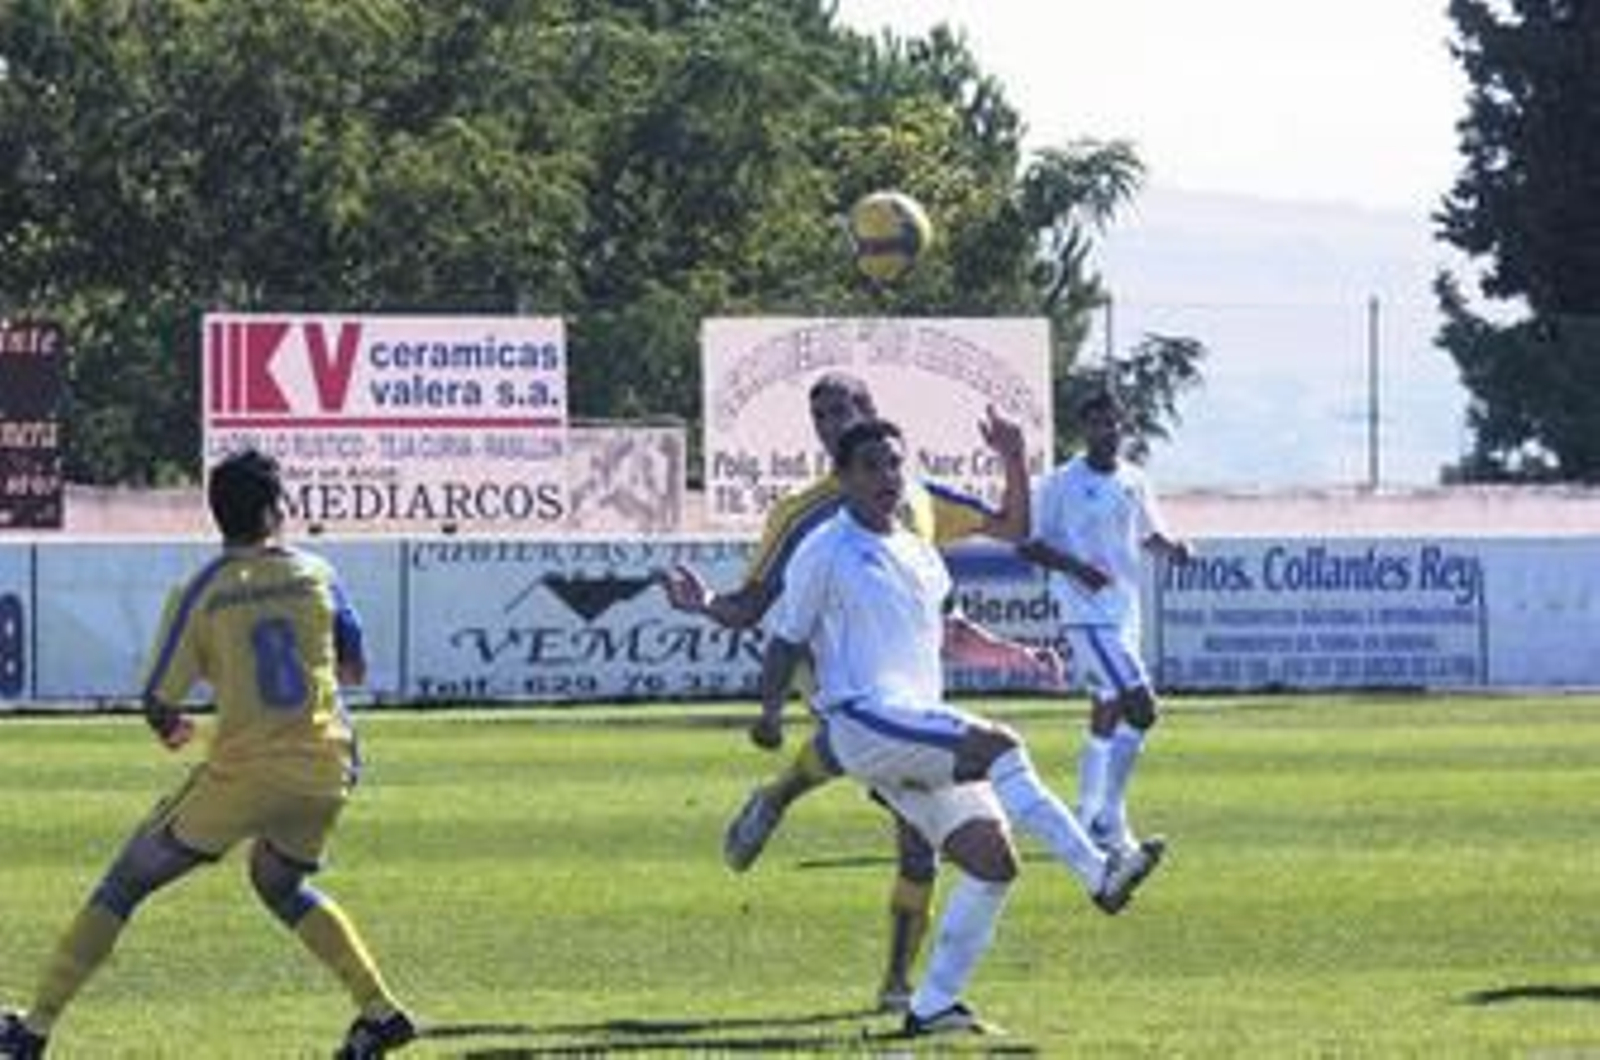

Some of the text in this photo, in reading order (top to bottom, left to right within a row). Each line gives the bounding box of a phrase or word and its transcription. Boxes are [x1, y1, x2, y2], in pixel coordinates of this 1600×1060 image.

[370, 337, 559, 370] ceramicas
[370, 375, 560, 408] valera s.a.
[280, 482, 563, 520] MEDIARCOS
[1263, 546, 1412, 591] Collantes
[1419, 546, 1477, 606] Rey
[450, 618, 763, 665] VEMAR
